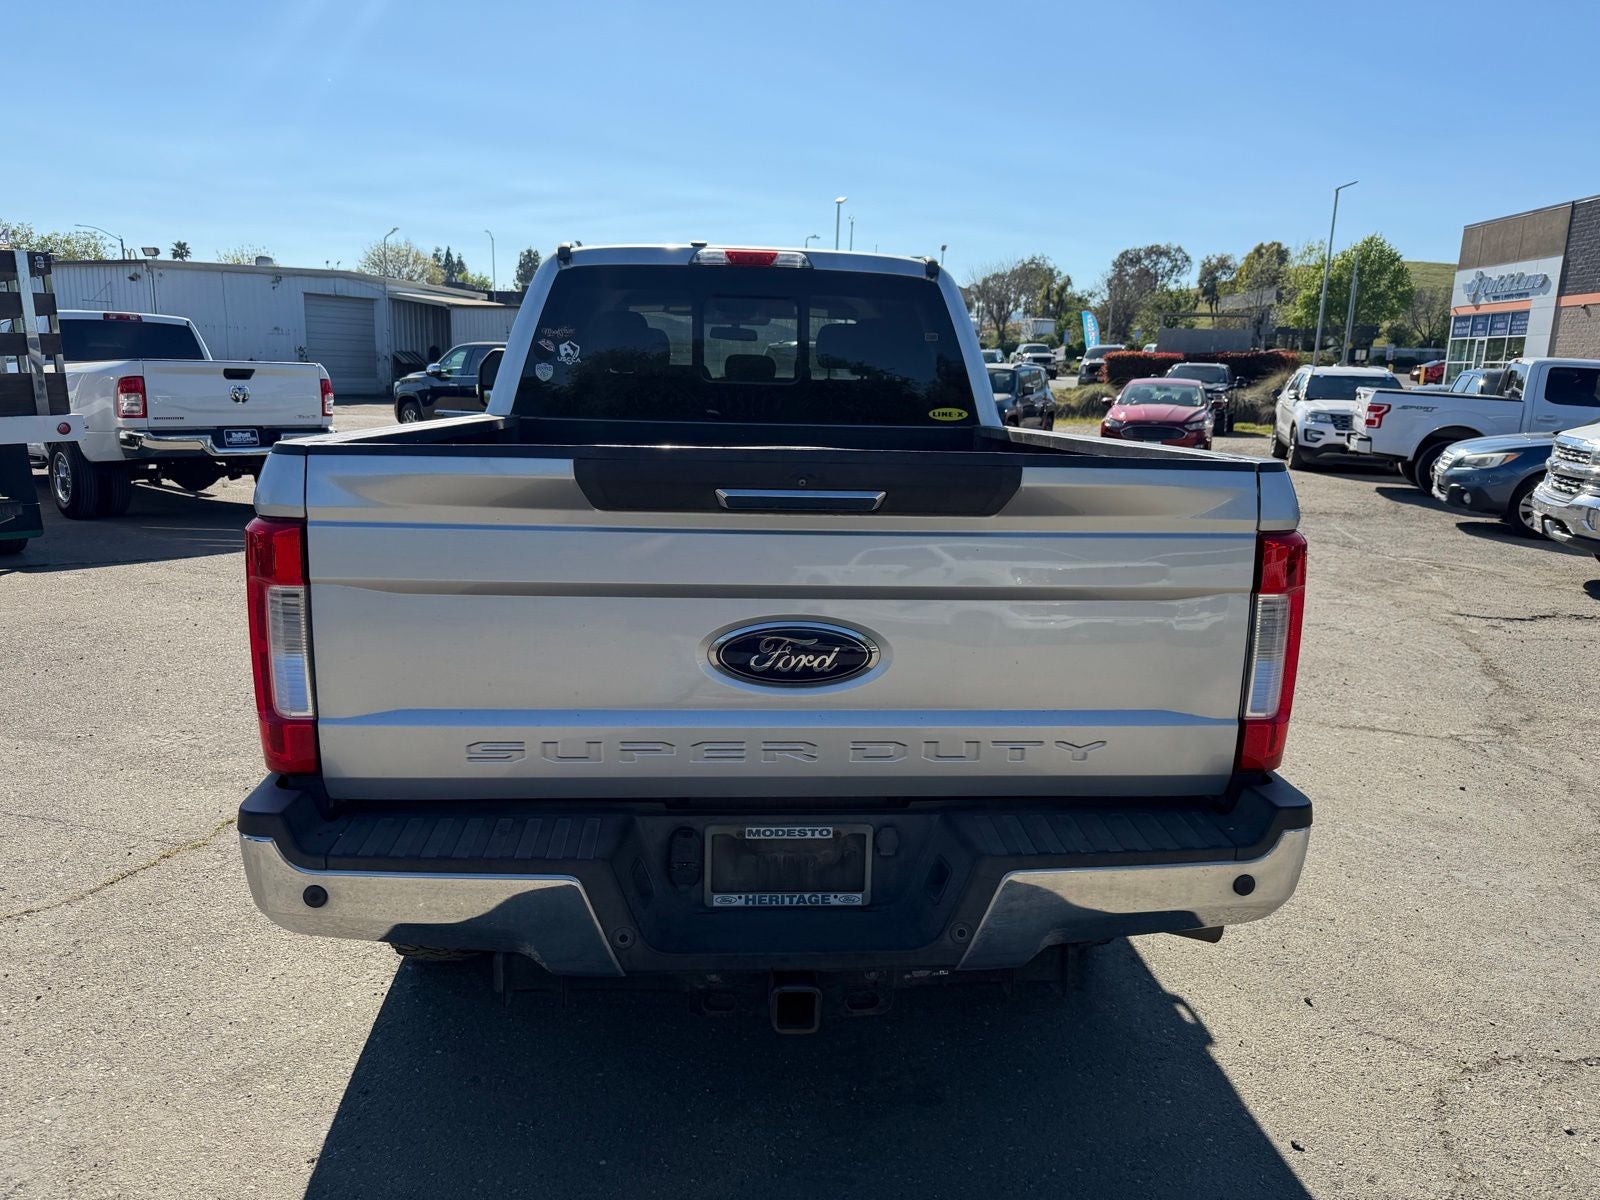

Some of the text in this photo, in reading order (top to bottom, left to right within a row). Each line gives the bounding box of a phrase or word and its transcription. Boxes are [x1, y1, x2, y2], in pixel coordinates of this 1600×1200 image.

[749, 636, 840, 672] Ford
[466, 740, 1108, 764] SUPER DUTY
[746, 827, 832, 838] MODESTO
[744, 894, 832, 905] HERITAGE
